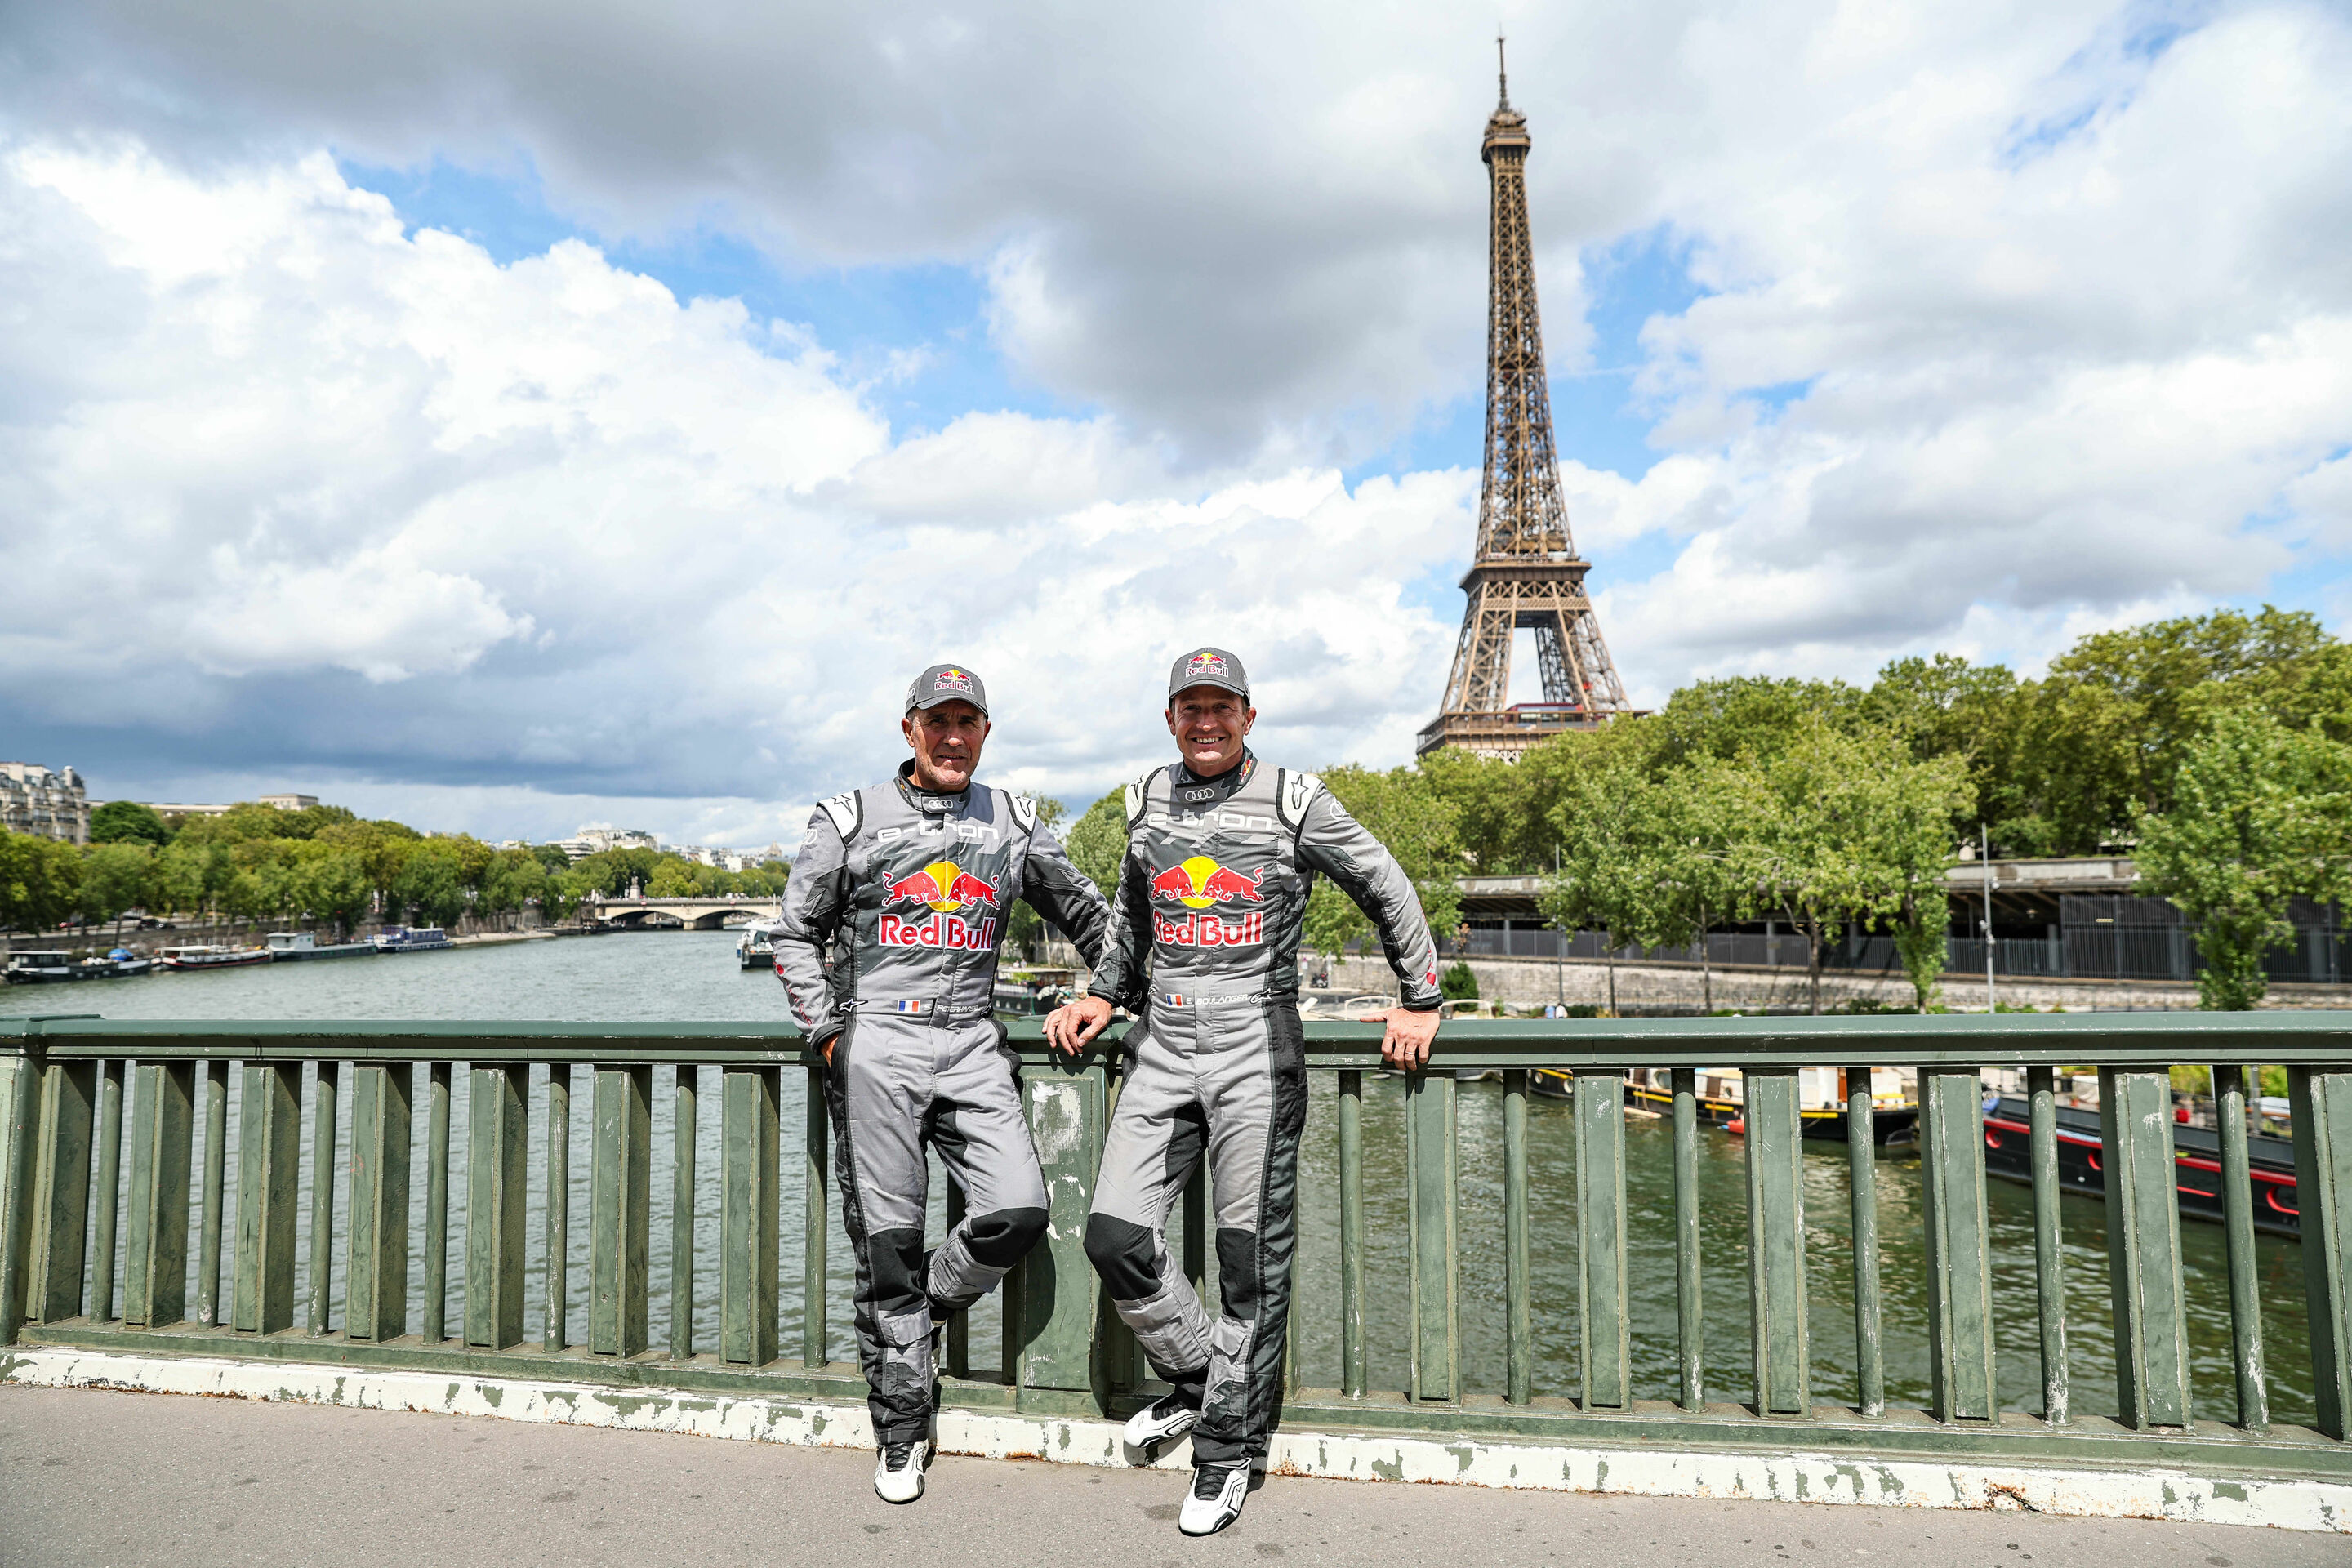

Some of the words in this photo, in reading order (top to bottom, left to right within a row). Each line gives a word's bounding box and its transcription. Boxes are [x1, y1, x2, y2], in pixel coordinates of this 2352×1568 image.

[1186, 664, 1206, 677] Red
[1208, 665, 1228, 677] Bull
[934, 680, 955, 690] Red
[956, 682, 974, 694] Bull
[877, 819, 999, 842] e-tron
[1147, 808, 1272, 831] e-tron
[879, 913, 942, 947] Red
[946, 915, 996, 951] Bull
[1153, 909, 1196, 945] Red
[1198, 911, 1263, 947] Bull
[1196, 994, 1248, 1005] BOULANGER
